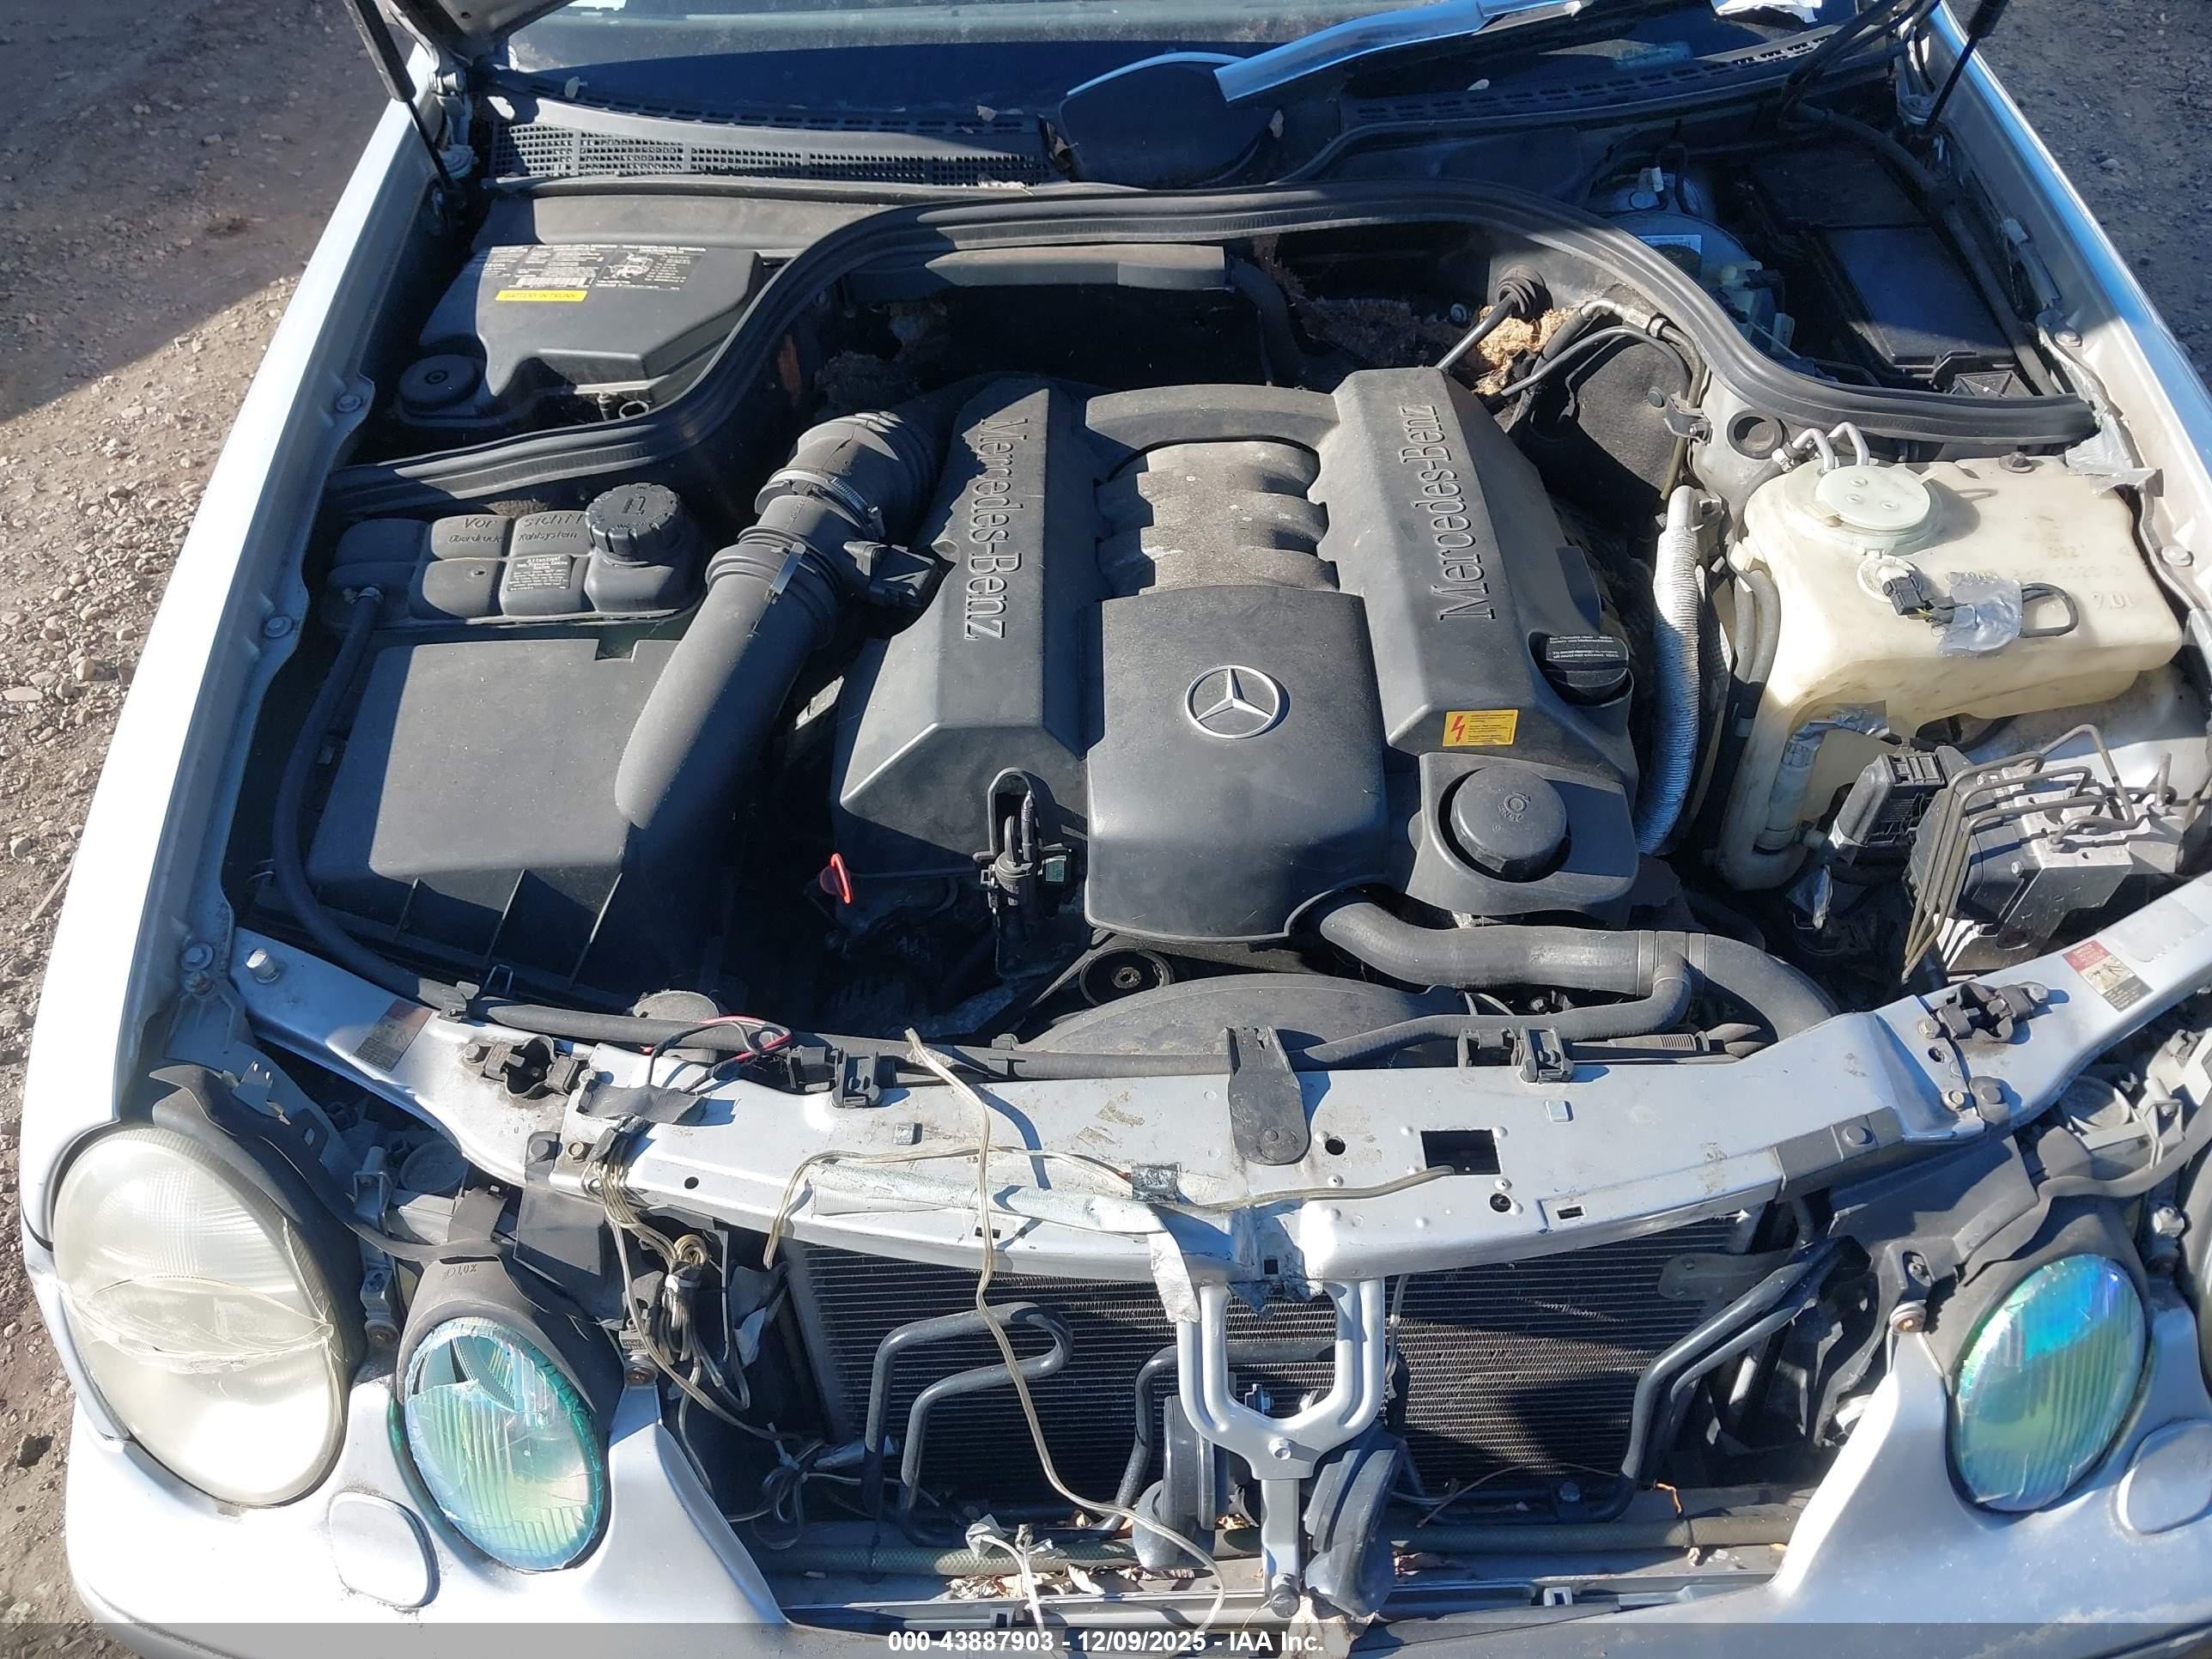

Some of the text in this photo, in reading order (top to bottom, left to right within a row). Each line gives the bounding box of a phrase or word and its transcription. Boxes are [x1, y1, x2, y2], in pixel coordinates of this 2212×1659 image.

[464, 517, 496, 529] Vor
[963, 417, 1029, 641] Mercedes-Benz
[1398, 404, 1497, 621] Mercedes-Benz
